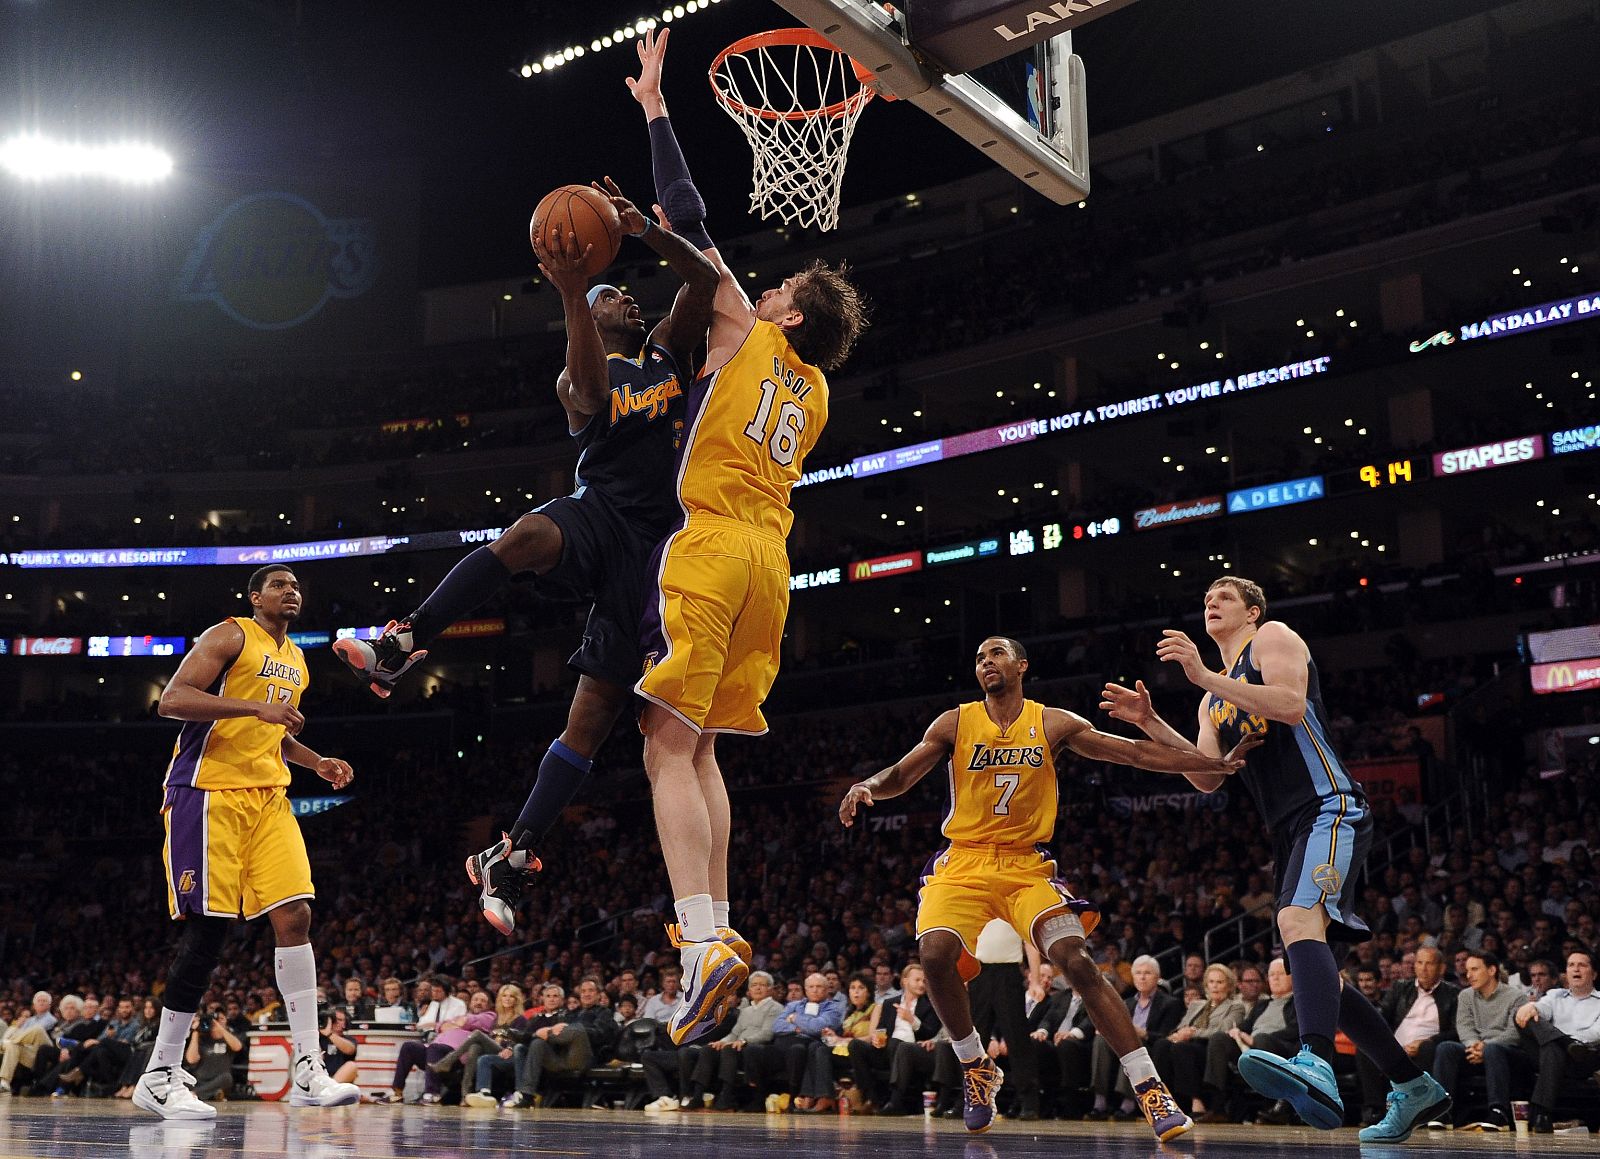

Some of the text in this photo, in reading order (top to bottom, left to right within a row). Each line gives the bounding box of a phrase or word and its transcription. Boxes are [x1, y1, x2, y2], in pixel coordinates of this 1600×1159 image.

[993, 0, 1111, 42] LAK
[1460, 302, 1572, 340] MANDALAY
[742, 377, 806, 468] 16
[998, 419, 1048, 444] YOU'RE
[1050, 411, 1081, 432] NOT
[1083, 409, 1096, 425] A
[1096, 393, 1162, 421] TOURIST.
[1164, 380, 1221, 406] YOU'RE
[1222, 378, 1237, 394] A
[862, 456, 887, 472] BAY
[1441, 437, 1534, 474] STAPLES
[1251, 480, 1322, 507] DELTA
[1134, 500, 1222, 529] Budweiser
[1009, 529, 1033, 545] LAL
[1086, 517, 1120, 537] 4:49
[0, 552, 8, 564] A
[64, 551, 106, 565] YOU'RE
[107, 552, 118, 564] A
[272, 543, 338, 560] MANDALAY
[339, 541, 361, 554] BAY
[808, 567, 841, 587] LAKE
[255, 653, 301, 687] LAKERS
[265, 683, 294, 704] 17
[966, 743, 1046, 772] LAKERS
[992, 773, 1022, 817] 7
